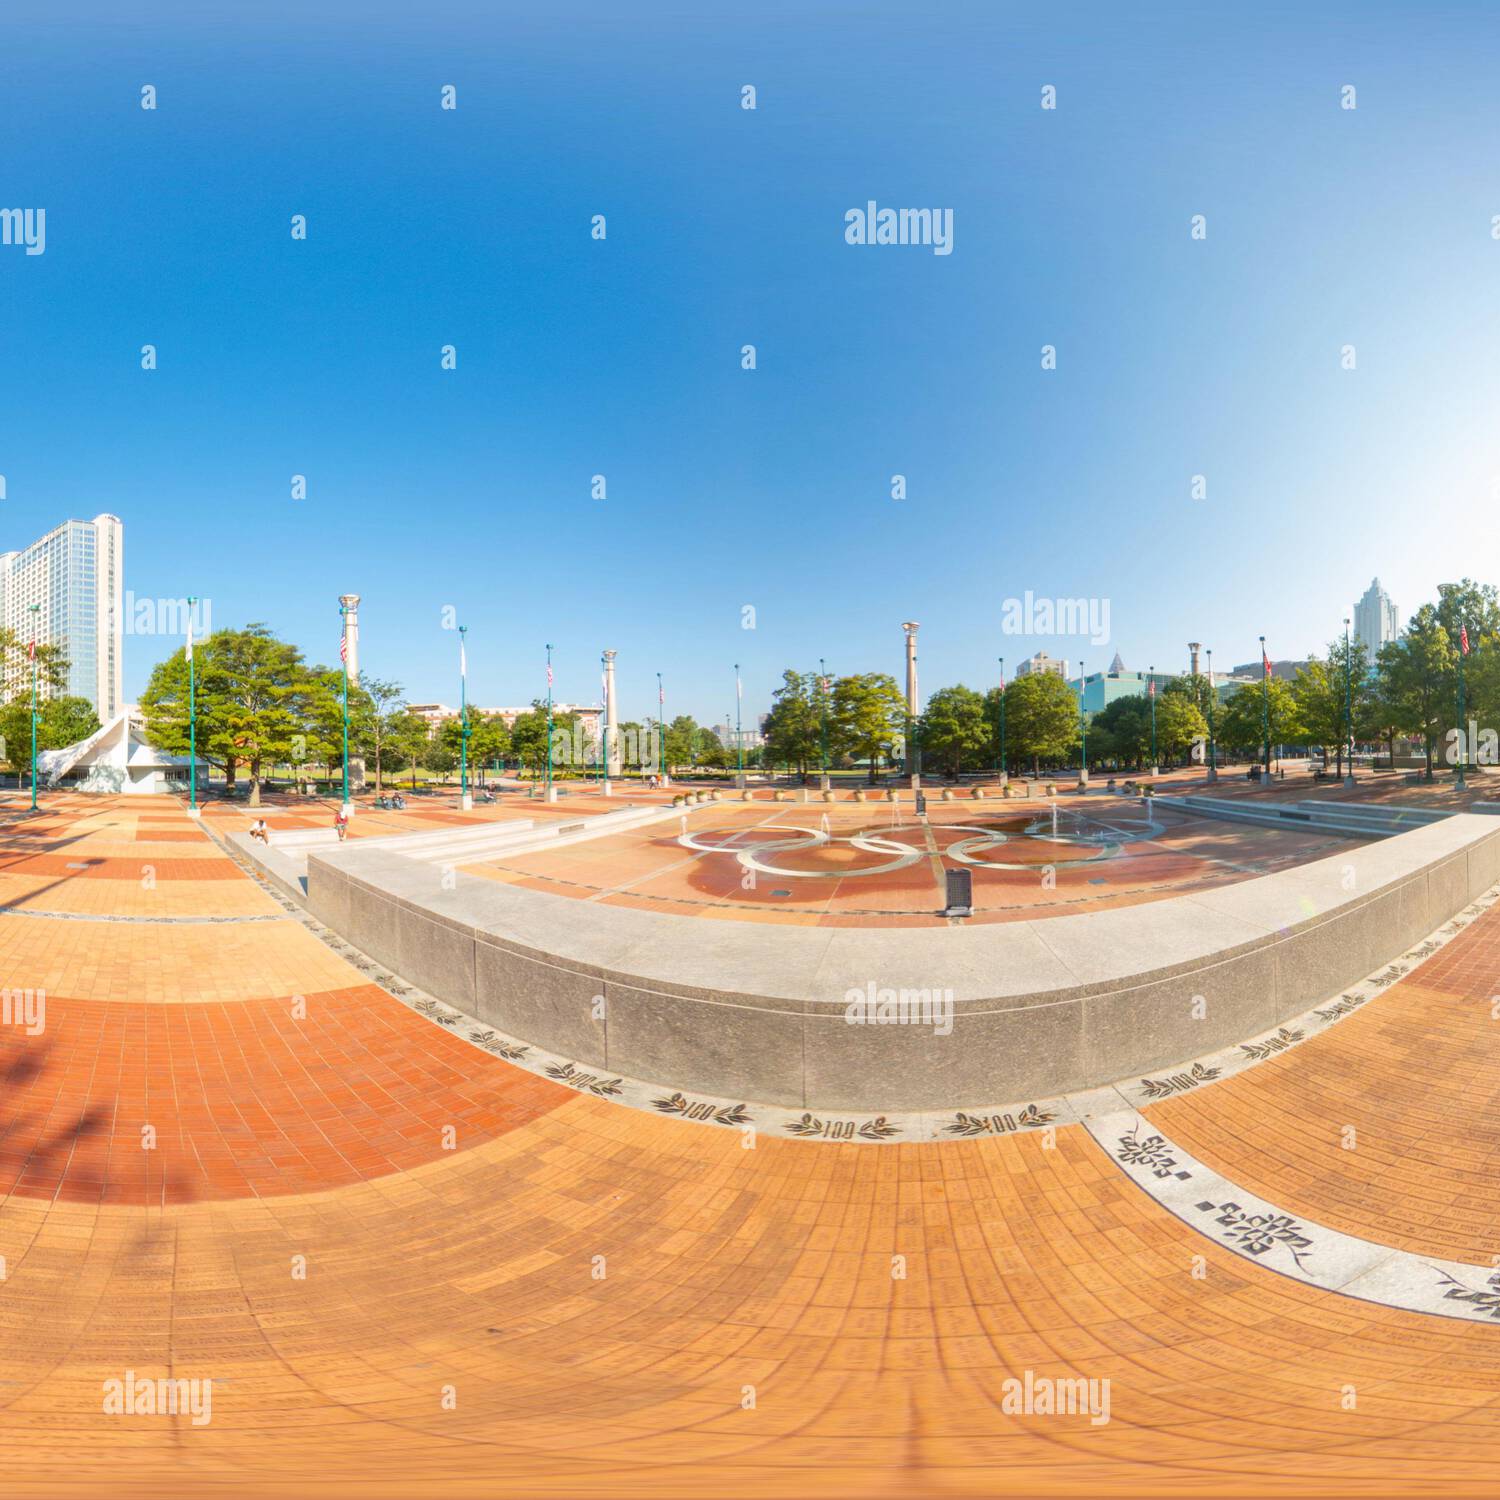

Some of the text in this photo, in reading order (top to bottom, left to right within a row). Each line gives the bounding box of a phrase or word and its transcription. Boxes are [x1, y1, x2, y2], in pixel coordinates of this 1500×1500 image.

[1165, 1073, 1199, 1092] 100
[681, 1102, 716, 1120] 100
[823, 1120, 855, 1139] 100
